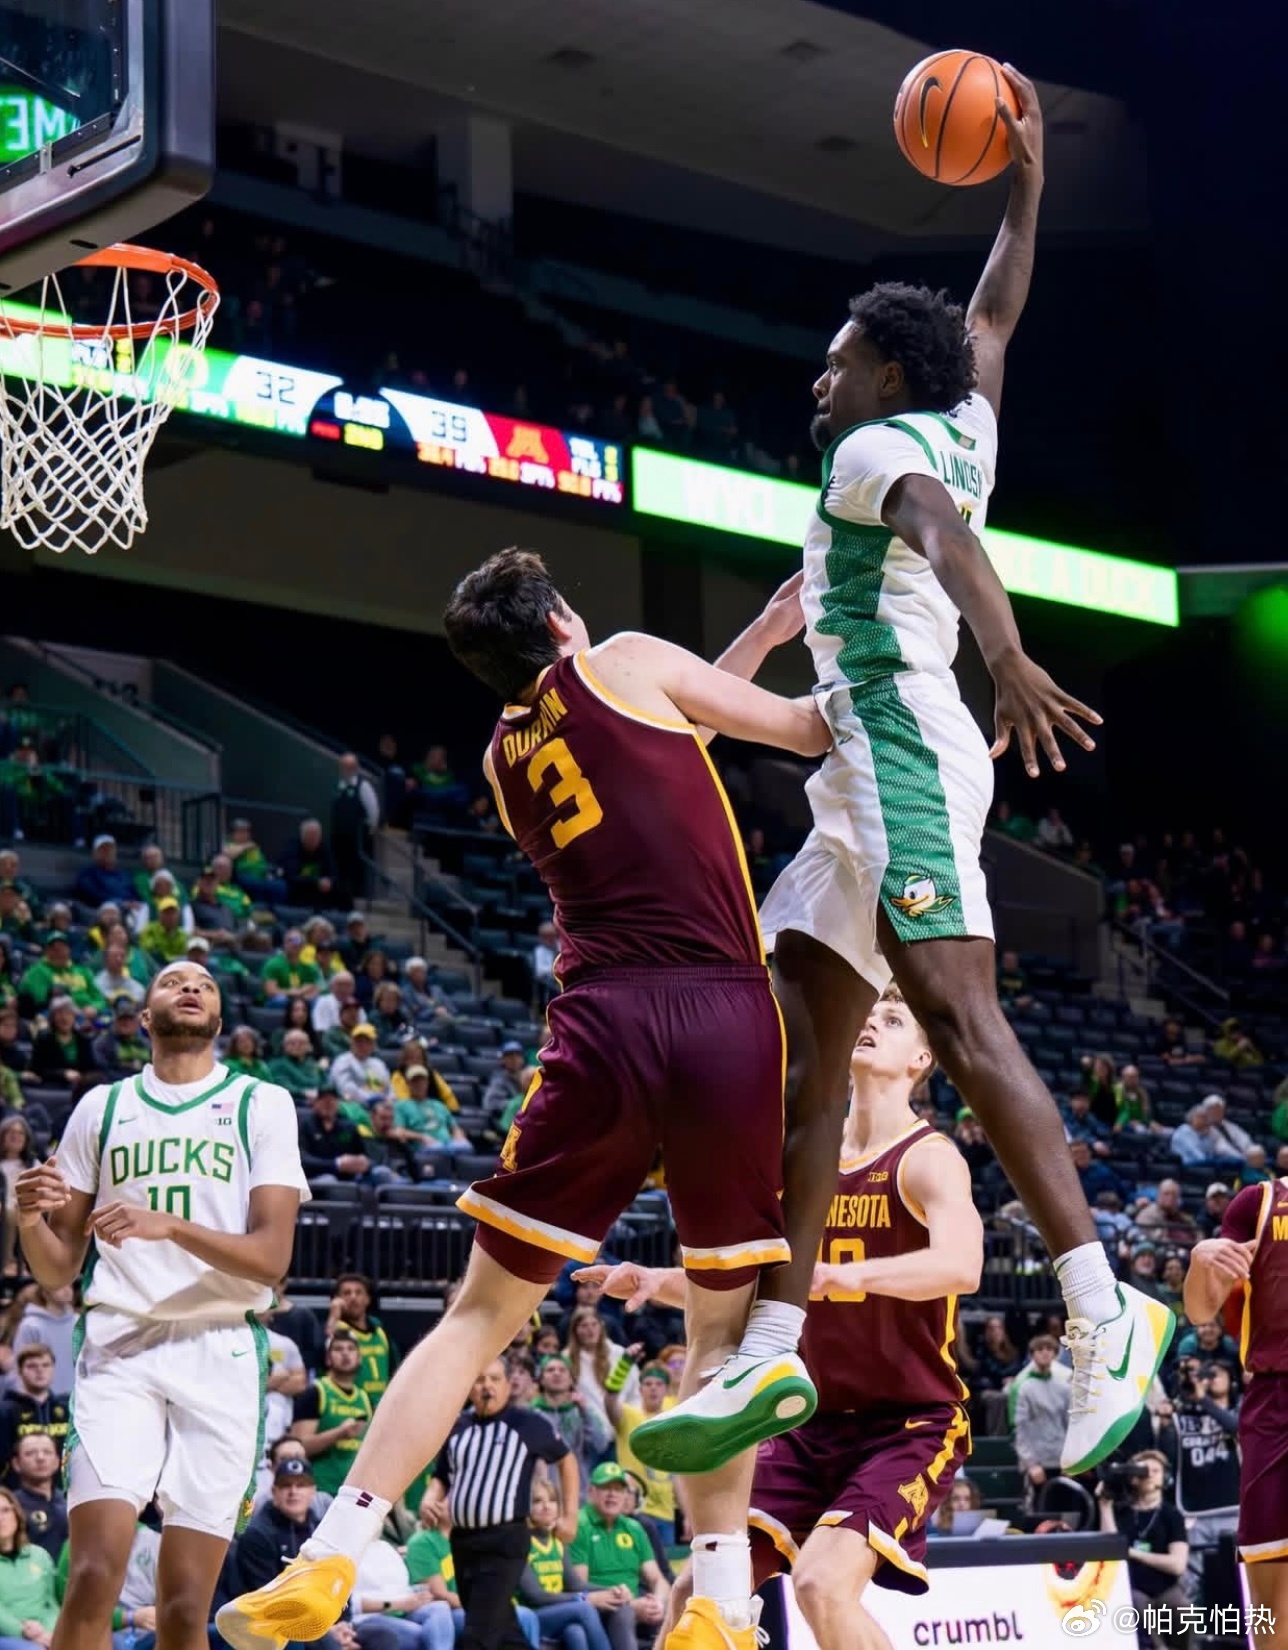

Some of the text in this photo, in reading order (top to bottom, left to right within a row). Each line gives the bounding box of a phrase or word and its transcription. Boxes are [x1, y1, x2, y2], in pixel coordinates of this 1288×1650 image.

[256, 371, 295, 404] 32
[431, 410, 467, 442] 39
[527, 738, 604, 849] 3
[110, 1137, 235, 1186] DUCKS
[914, 1611, 1023, 1646] crumbl
